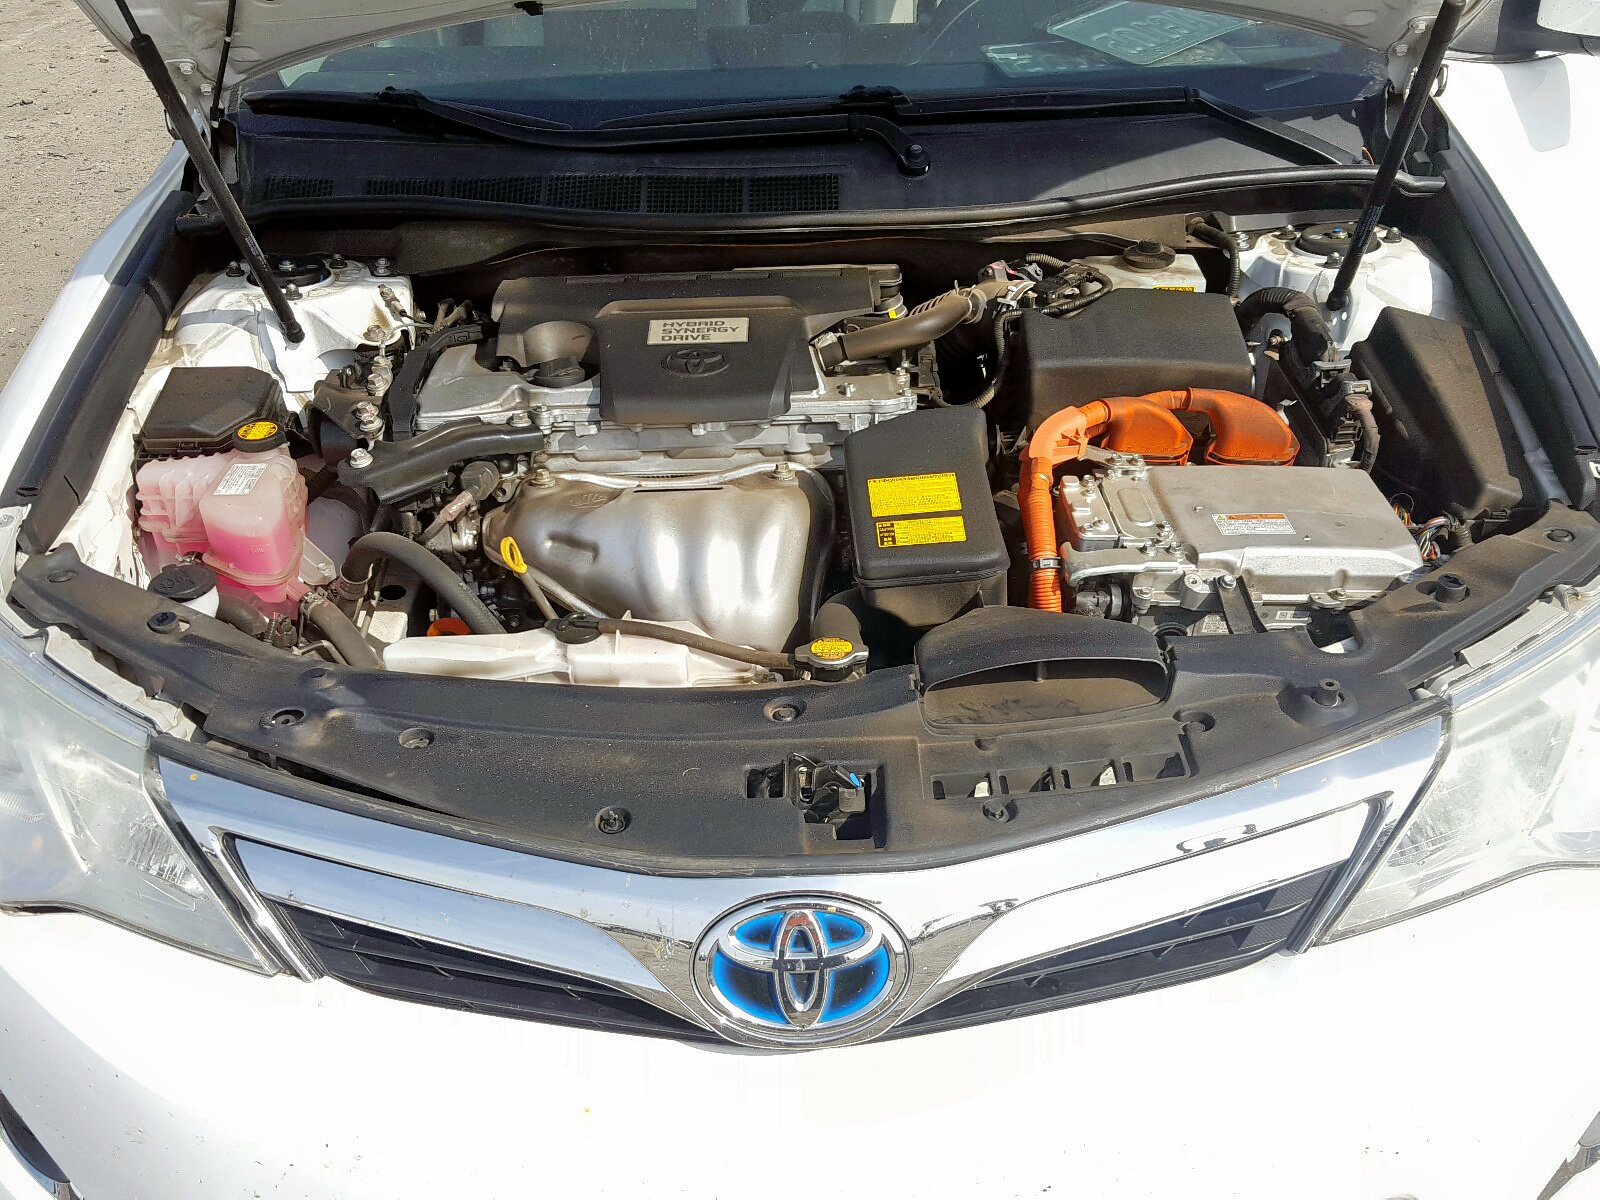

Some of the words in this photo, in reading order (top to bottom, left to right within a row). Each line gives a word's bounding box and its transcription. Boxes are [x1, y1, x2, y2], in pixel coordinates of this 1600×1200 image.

[663, 320, 725, 328] HYBRID
[662, 326, 739, 335] SYNERGY
[661, 333, 712, 341] DRIVE
